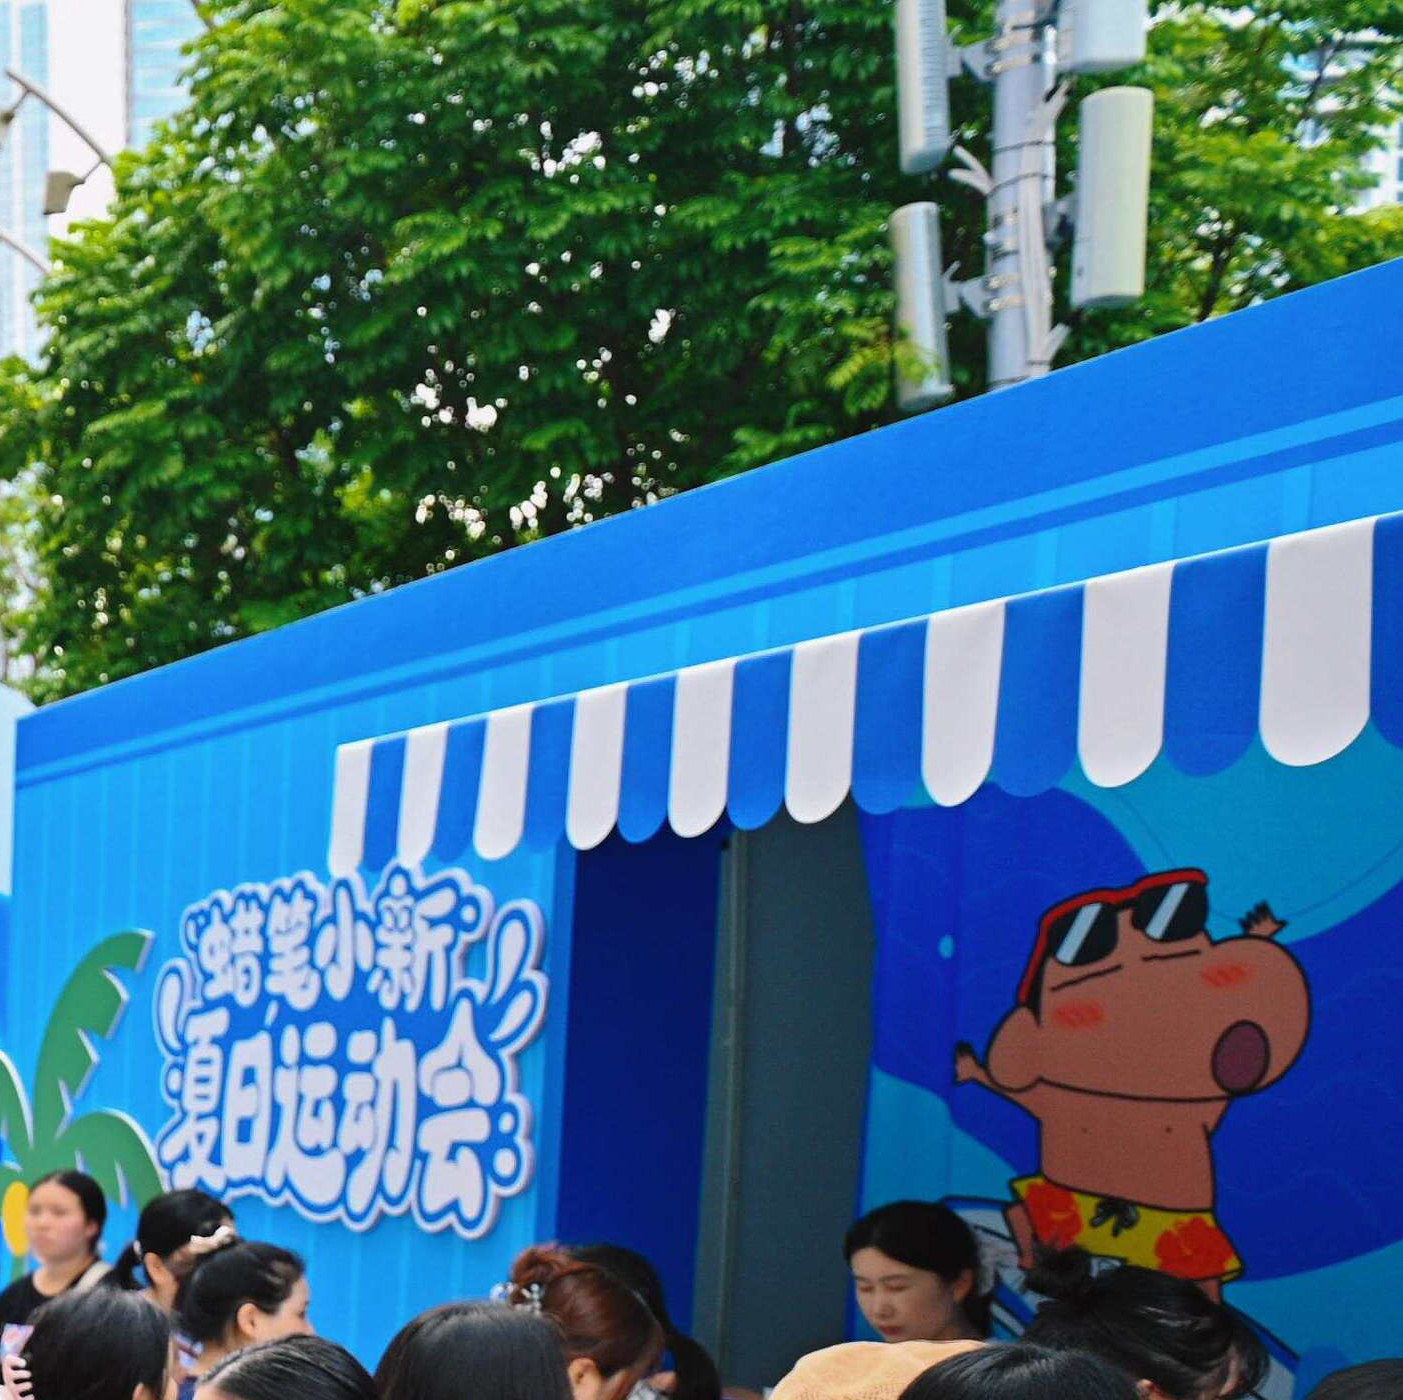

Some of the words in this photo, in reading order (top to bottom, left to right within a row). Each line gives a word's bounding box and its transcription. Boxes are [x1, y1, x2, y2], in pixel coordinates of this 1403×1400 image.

[198, 873, 456, 1012] 蜡笔小新
[161, 997, 500, 1221] 夏日运动会
